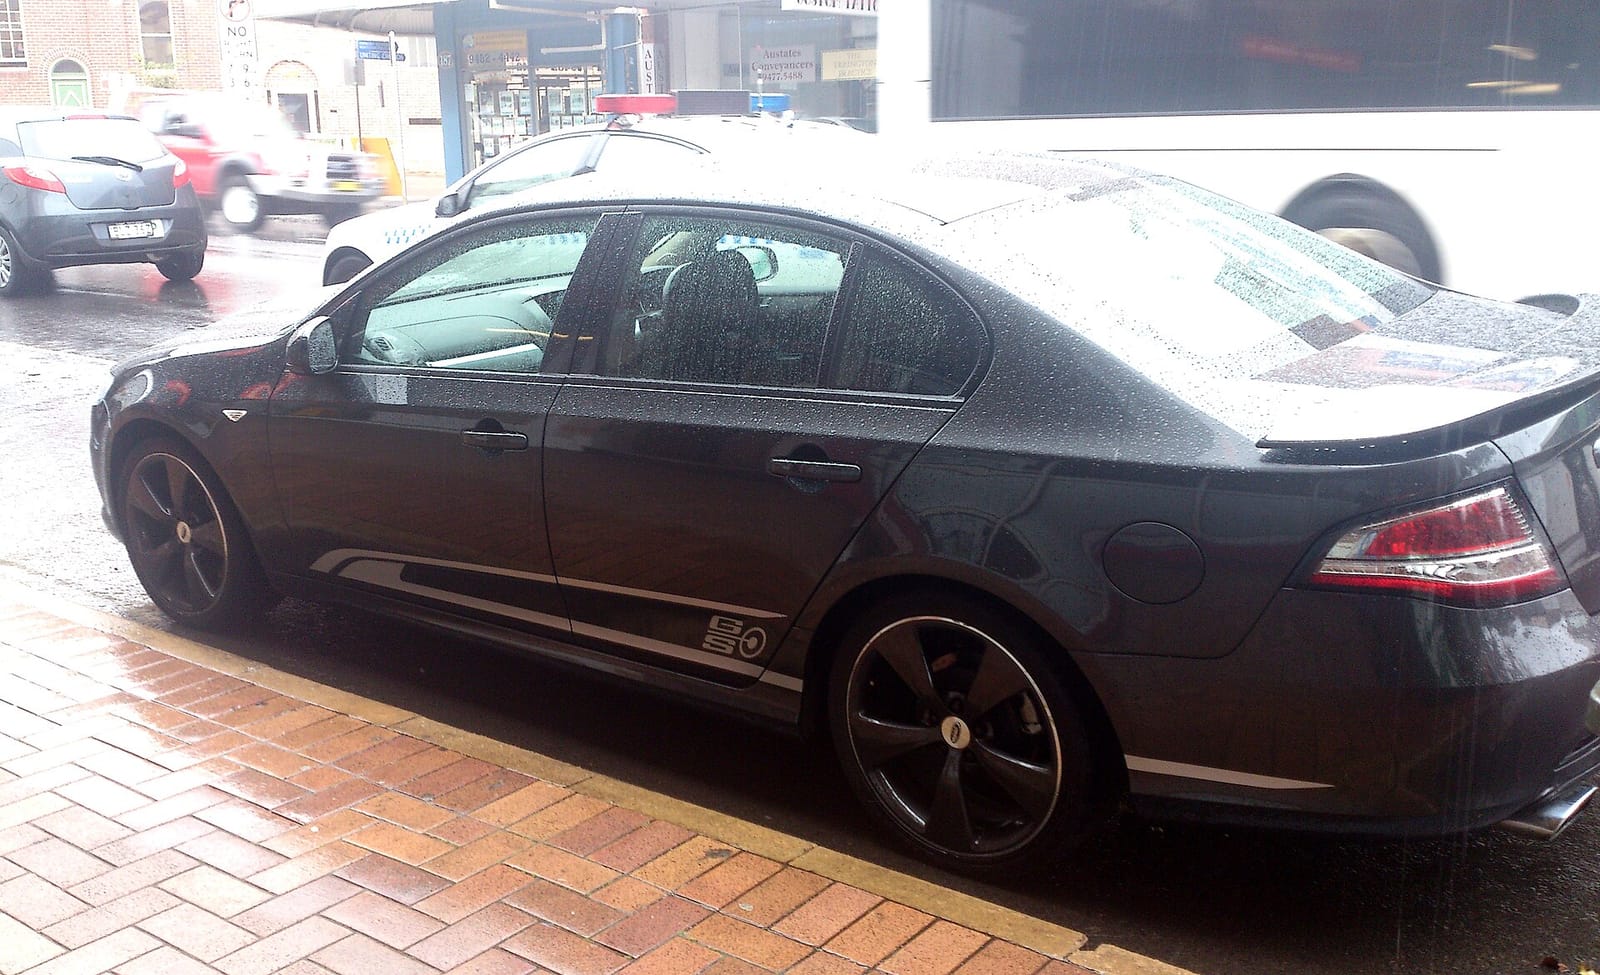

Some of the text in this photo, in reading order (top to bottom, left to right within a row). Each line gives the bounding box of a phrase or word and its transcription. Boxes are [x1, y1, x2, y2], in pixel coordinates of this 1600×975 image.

[228, 26, 247, 37] NO
[763, 49, 802, 59] Austates
[752, 61, 814, 73] Conveyancers
